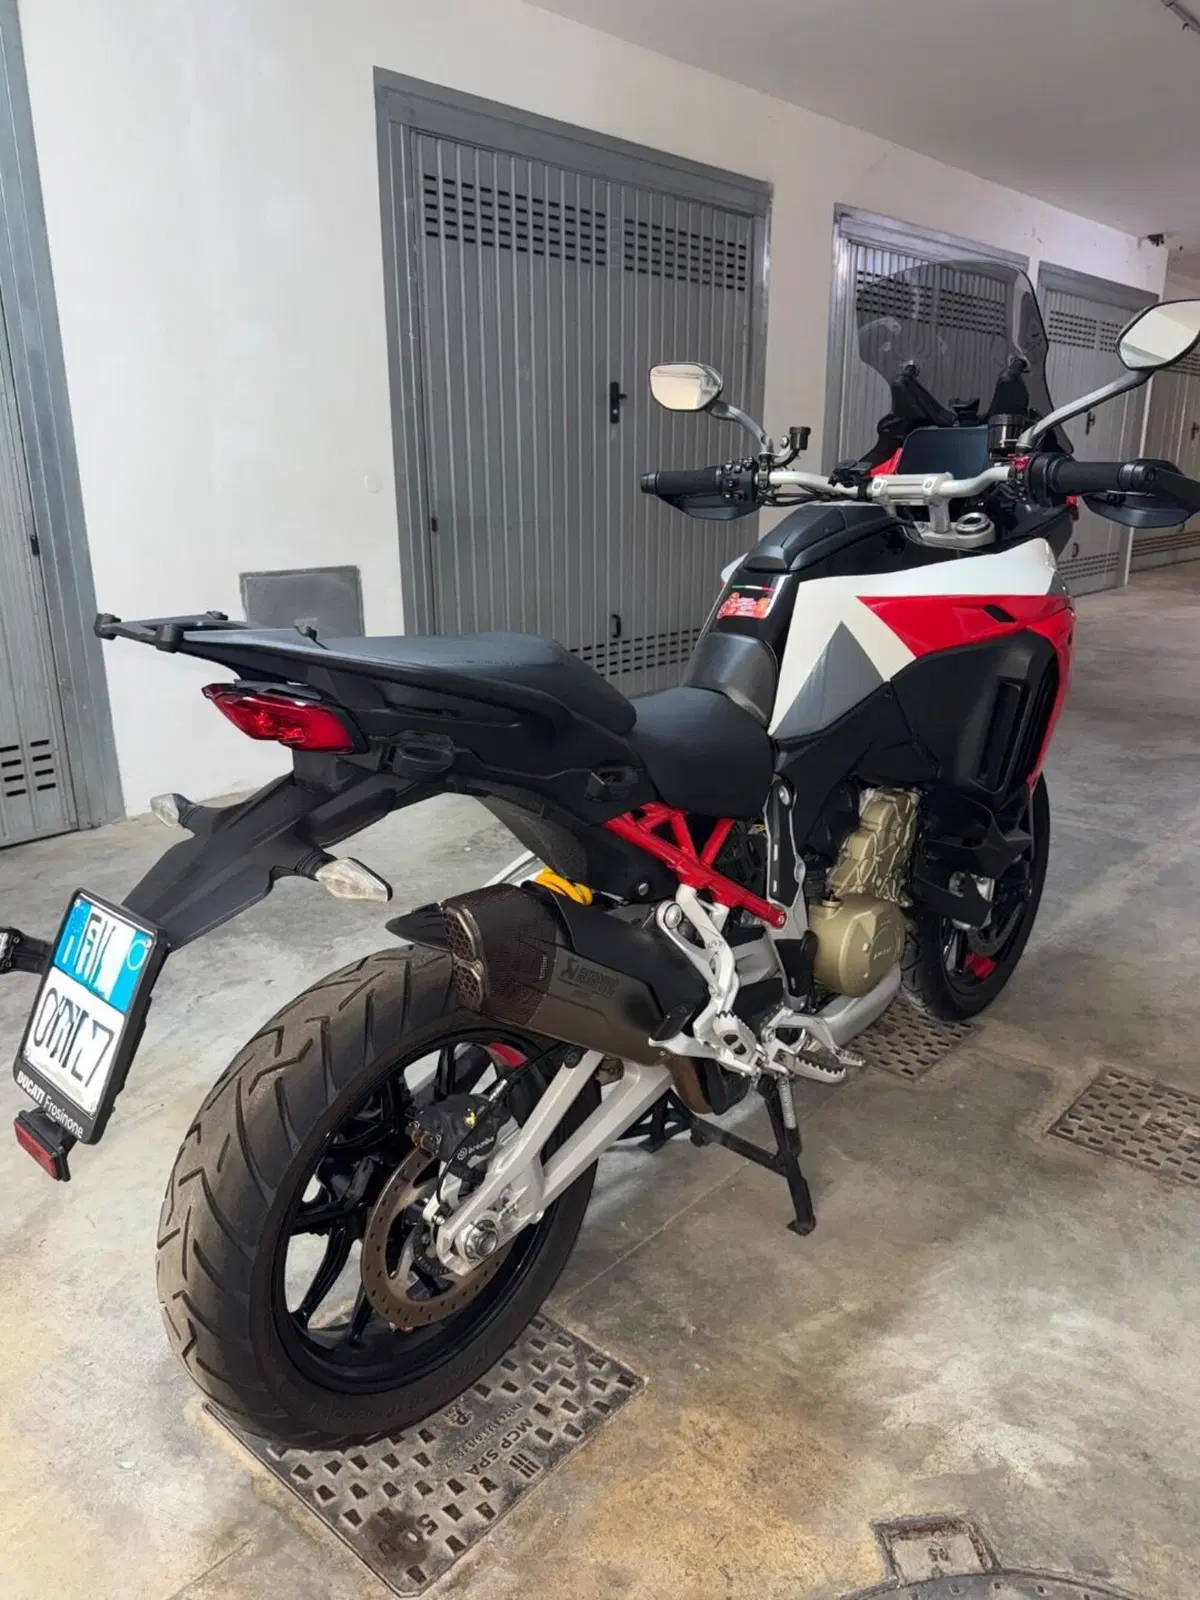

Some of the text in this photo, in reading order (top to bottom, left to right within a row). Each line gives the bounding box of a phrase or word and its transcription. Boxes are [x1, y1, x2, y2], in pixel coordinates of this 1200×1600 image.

[17, 1070, 83, 1138] DUCATI Frosinone
[464, 1416, 534, 1474] MCP SPA
